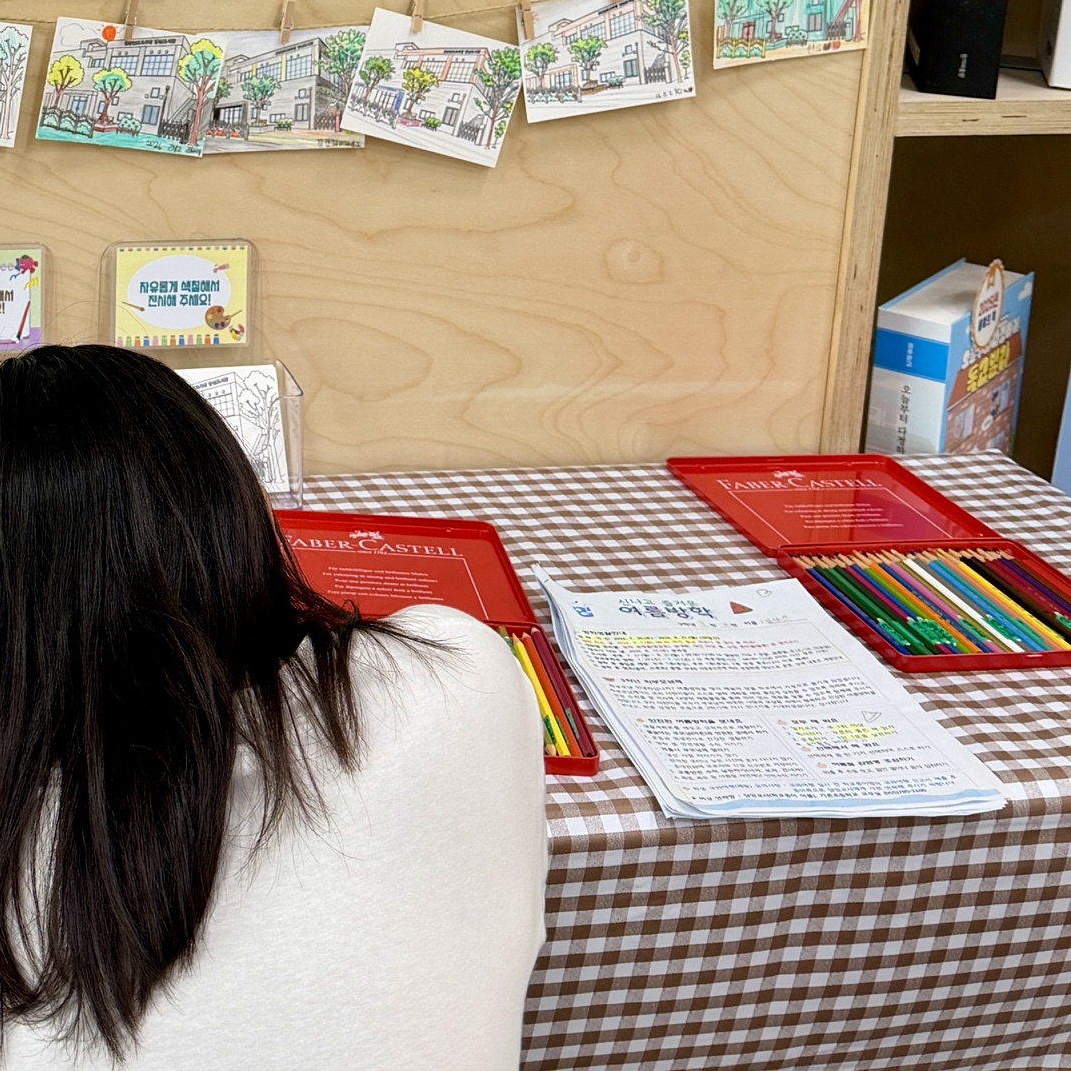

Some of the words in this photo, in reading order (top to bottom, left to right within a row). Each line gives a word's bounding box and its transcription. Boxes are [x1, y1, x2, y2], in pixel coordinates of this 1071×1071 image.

[140, 281, 178, 293] 자유롭게
[181, 280, 220, 293] 색칠해서
[148, 294, 177, 307] 전시해
[180, 293, 211, 306] 주세요!
[619, 598, 655, 607] 신나고
[619, 605, 718, 620] 여름방학
